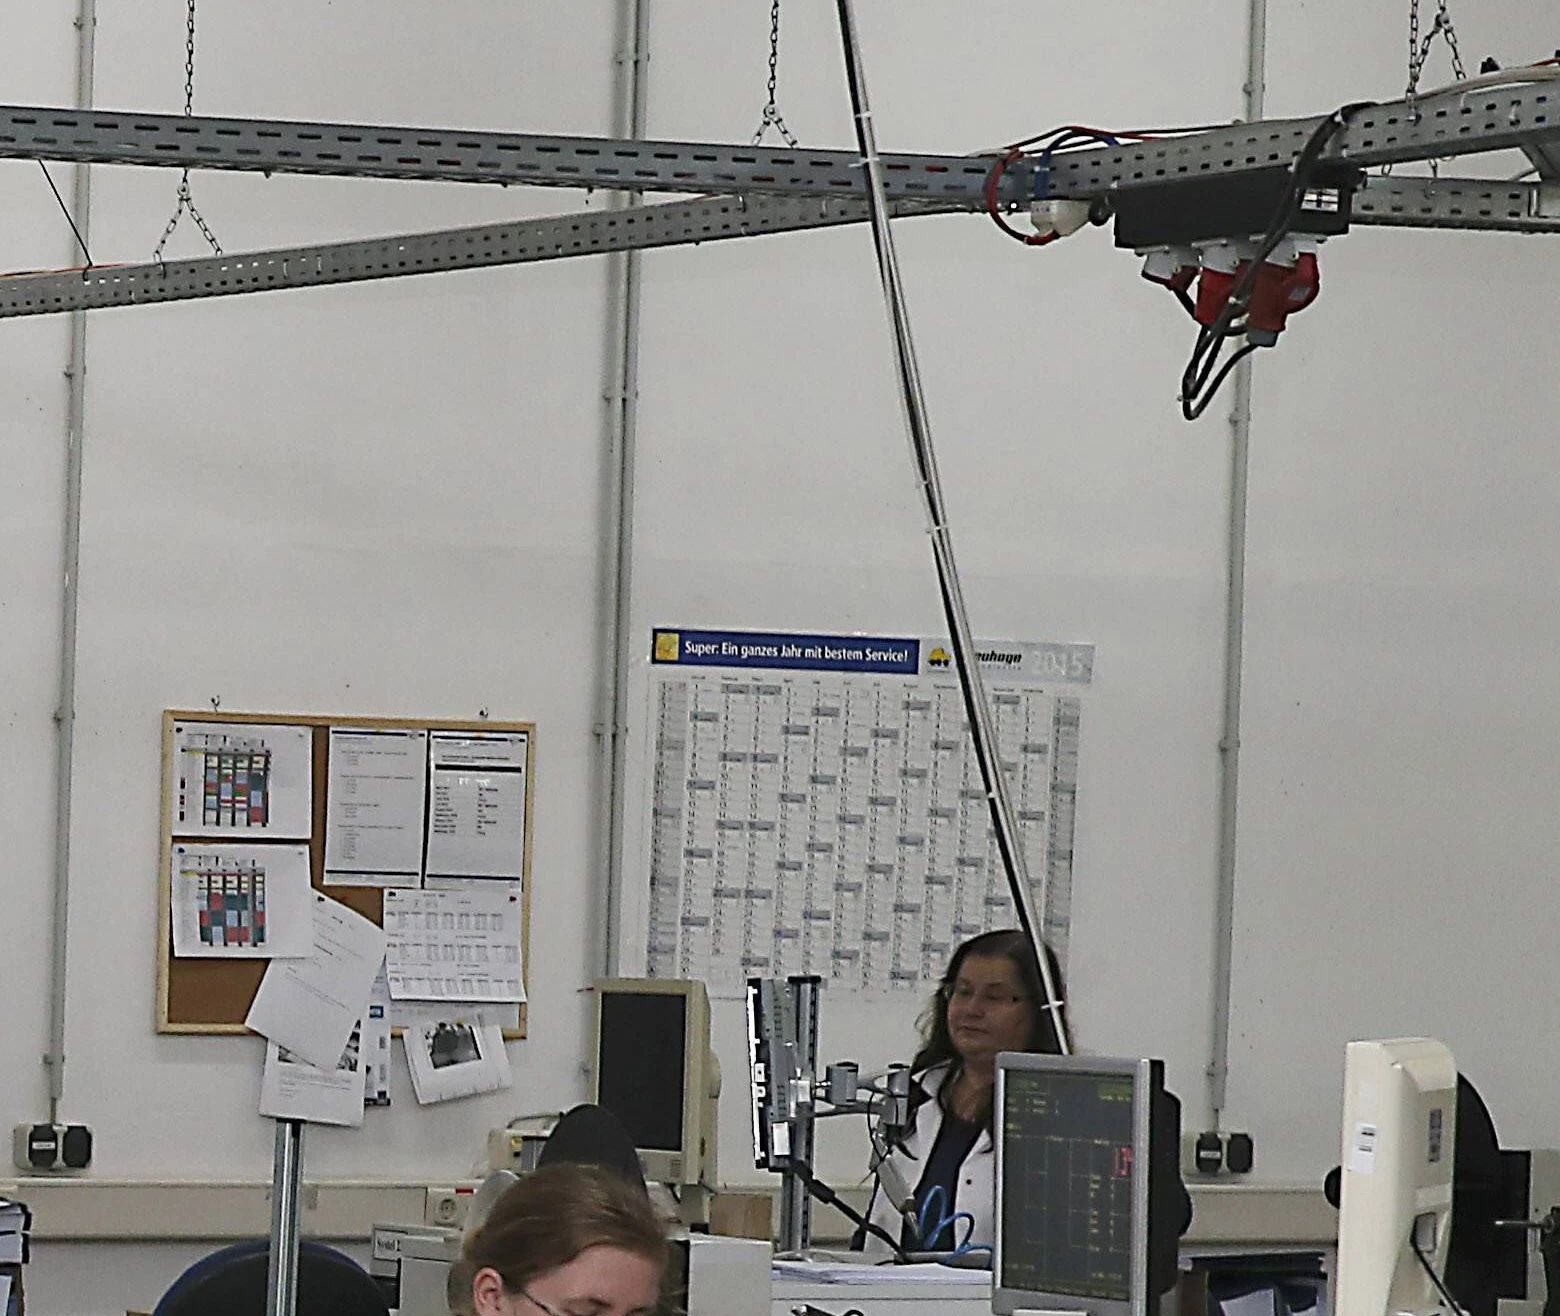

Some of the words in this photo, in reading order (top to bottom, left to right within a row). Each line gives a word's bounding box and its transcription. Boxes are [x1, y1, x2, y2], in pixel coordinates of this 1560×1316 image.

[685, 641, 719, 657] Super:
[721, 642, 738, 656] Ein
[741, 644, 778, 658] ganzes
[781, 643, 801, 658] Jahr
[804, 646, 822, 659] mit
[824, 645, 863, 660] bestem
[865, 647, 908, 662] Service!
